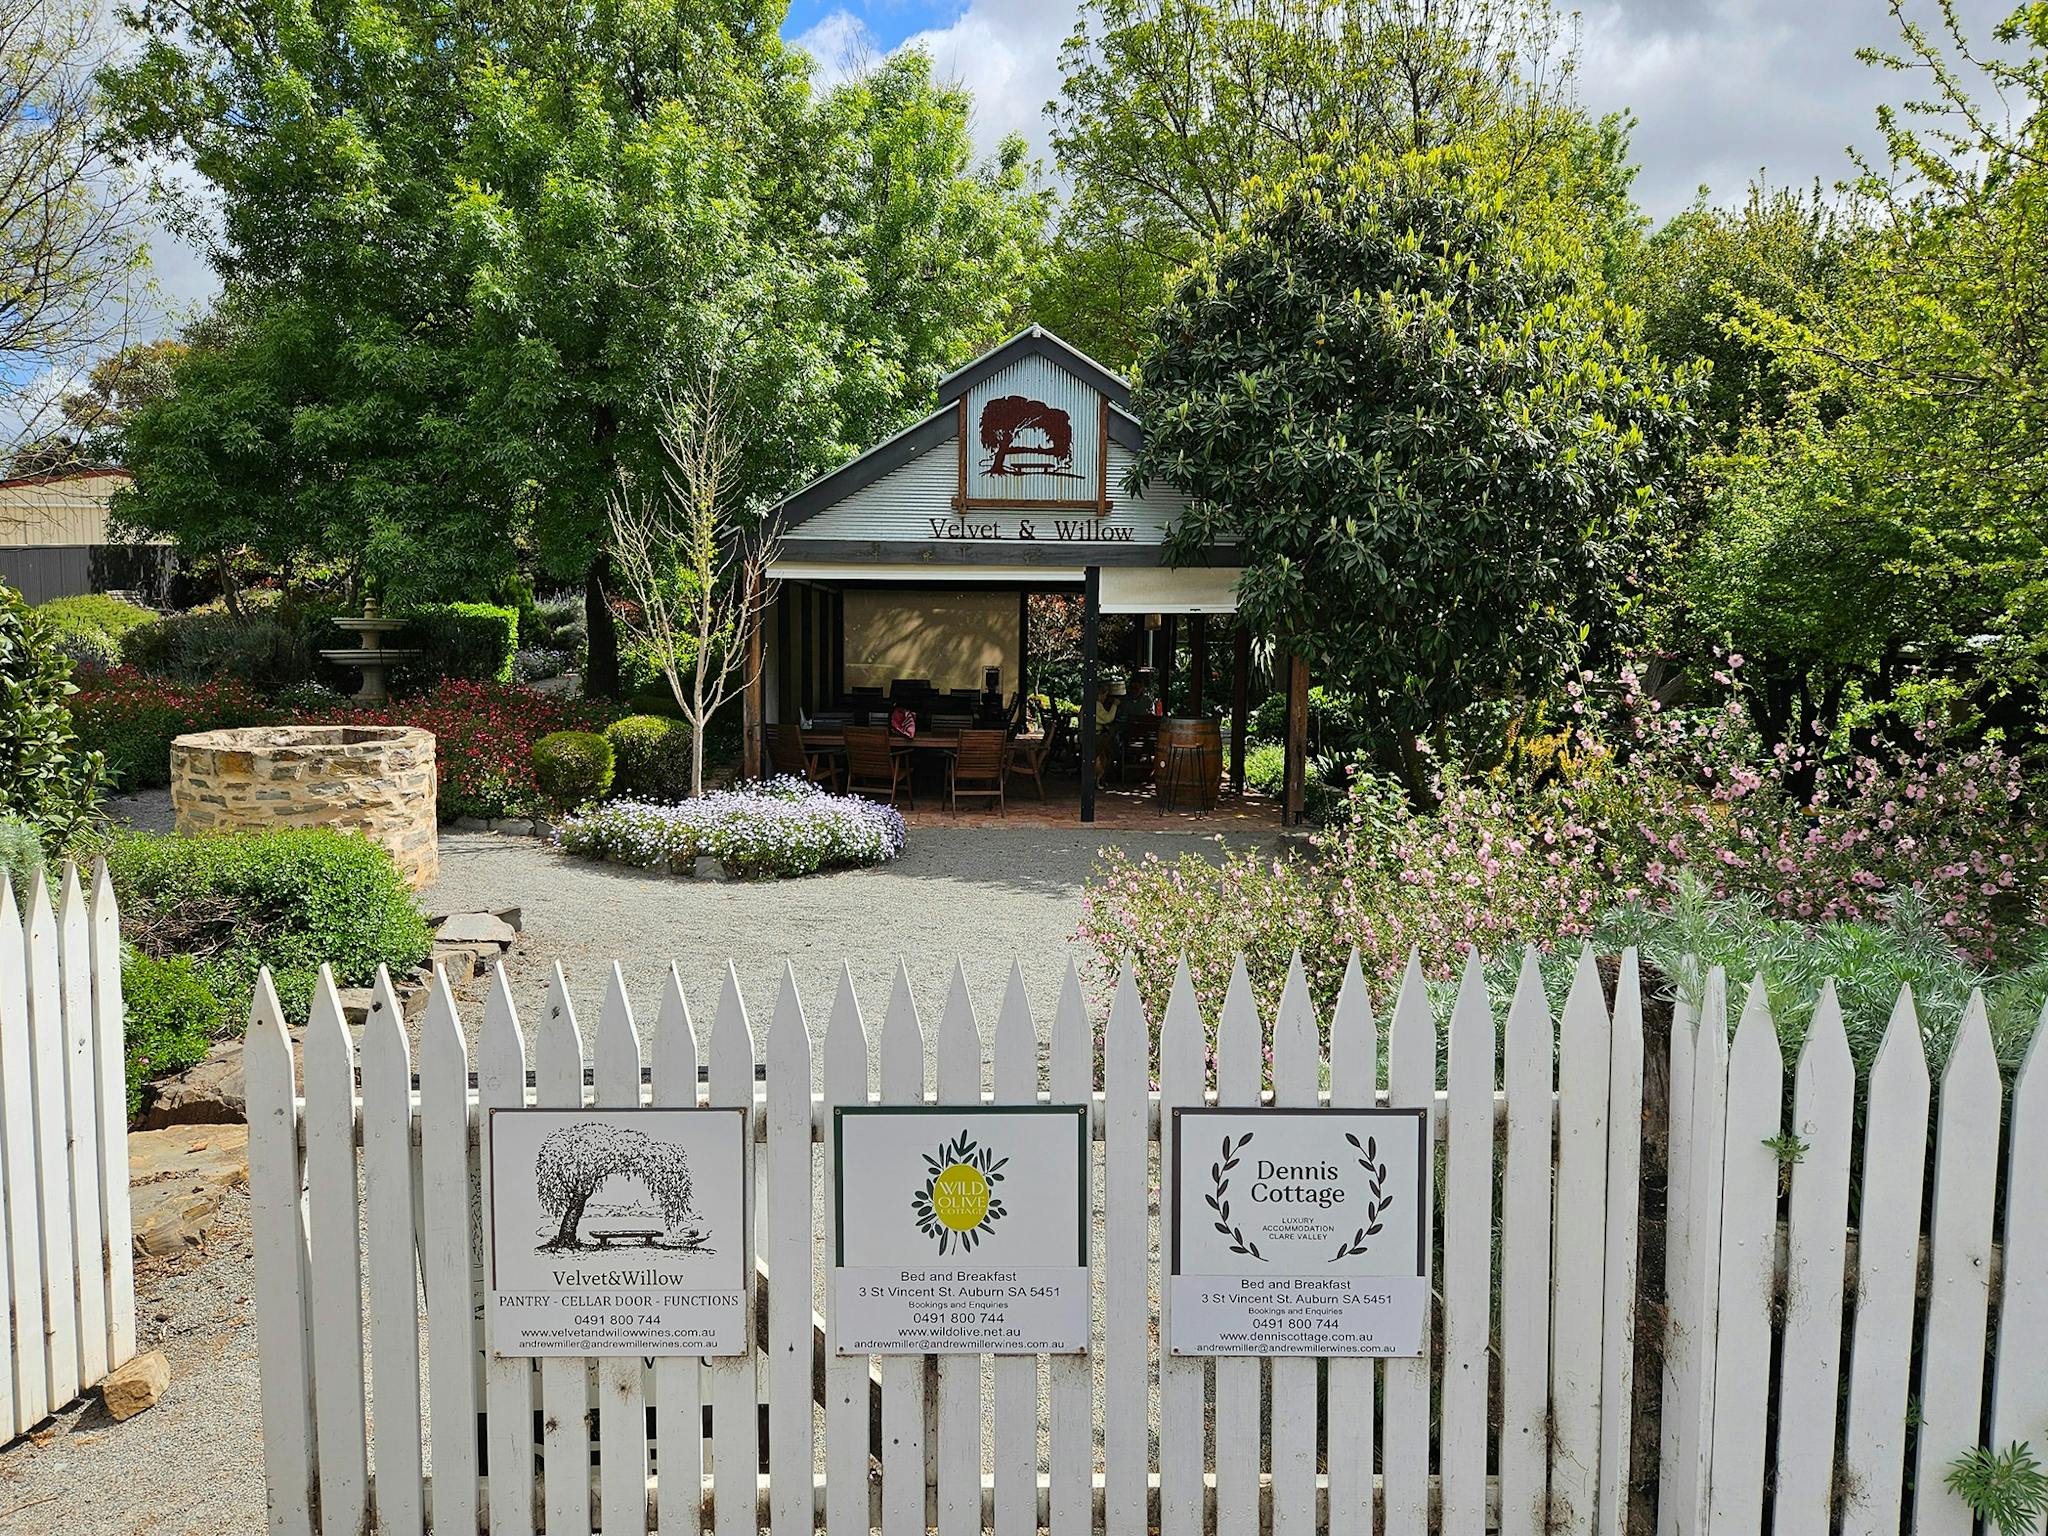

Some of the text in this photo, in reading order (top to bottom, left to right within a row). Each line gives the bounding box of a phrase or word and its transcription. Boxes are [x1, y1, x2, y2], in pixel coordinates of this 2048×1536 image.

[929, 517, 1135, 541] Velvet & Willow
[1257, 1160, 1338, 1180] Dennis
[940, 1181, 984, 1195] WILD
[1251, 1183, 1345, 1208] Cottage
[938, 1196, 985, 1208] OLIVE
[553, 1270, 684, 1286] Velvet&Willow
[901, 1271, 1016, 1282] Bed and Breakfast
[1241, 1279, 1351, 1290] Bed and Breakfast
[859, 1287, 1060, 1297] 3 St Vincent St. Auburn SA 5451
[499, 1296, 550, 1306] PANTRY
[561, 1296, 612, 1306] CELLAR
[615, 1296, 652, 1306] DOOR
[664, 1296, 739, 1306] FUNCTIONS
[1202, 1294, 1391, 1304] 3 St Vincent St. Auburn SA 5451
[908, 1301, 1008, 1310] Bookings and Enquiries
[1248, 1308, 1285, 1316] Bookings
[1306, 1308, 1342, 1316] Enquiries
[574, 1315, 661, 1325] 0491 800 744
[913, 1313, 1004, 1324] 0491 800 744
[1253, 1319, 1339, 1329] 0491 800 744
[521, 1328, 715, 1338] www.velvetandwillowwines.com.au
[898, 1327, 1021, 1337] www.wildolive.net.au
[1220, 1332, 1373, 1343] www.denniscottage.com.au
[519, 1340, 718, 1350] andrewmiller@andrewmillerwines.com.au
[854, 1340, 1064, 1350] andrewmiller@andrewmillerwines.com.au
[1197, 1344, 1396, 1353] andrewmiller@andrewmillerwines.com.au
